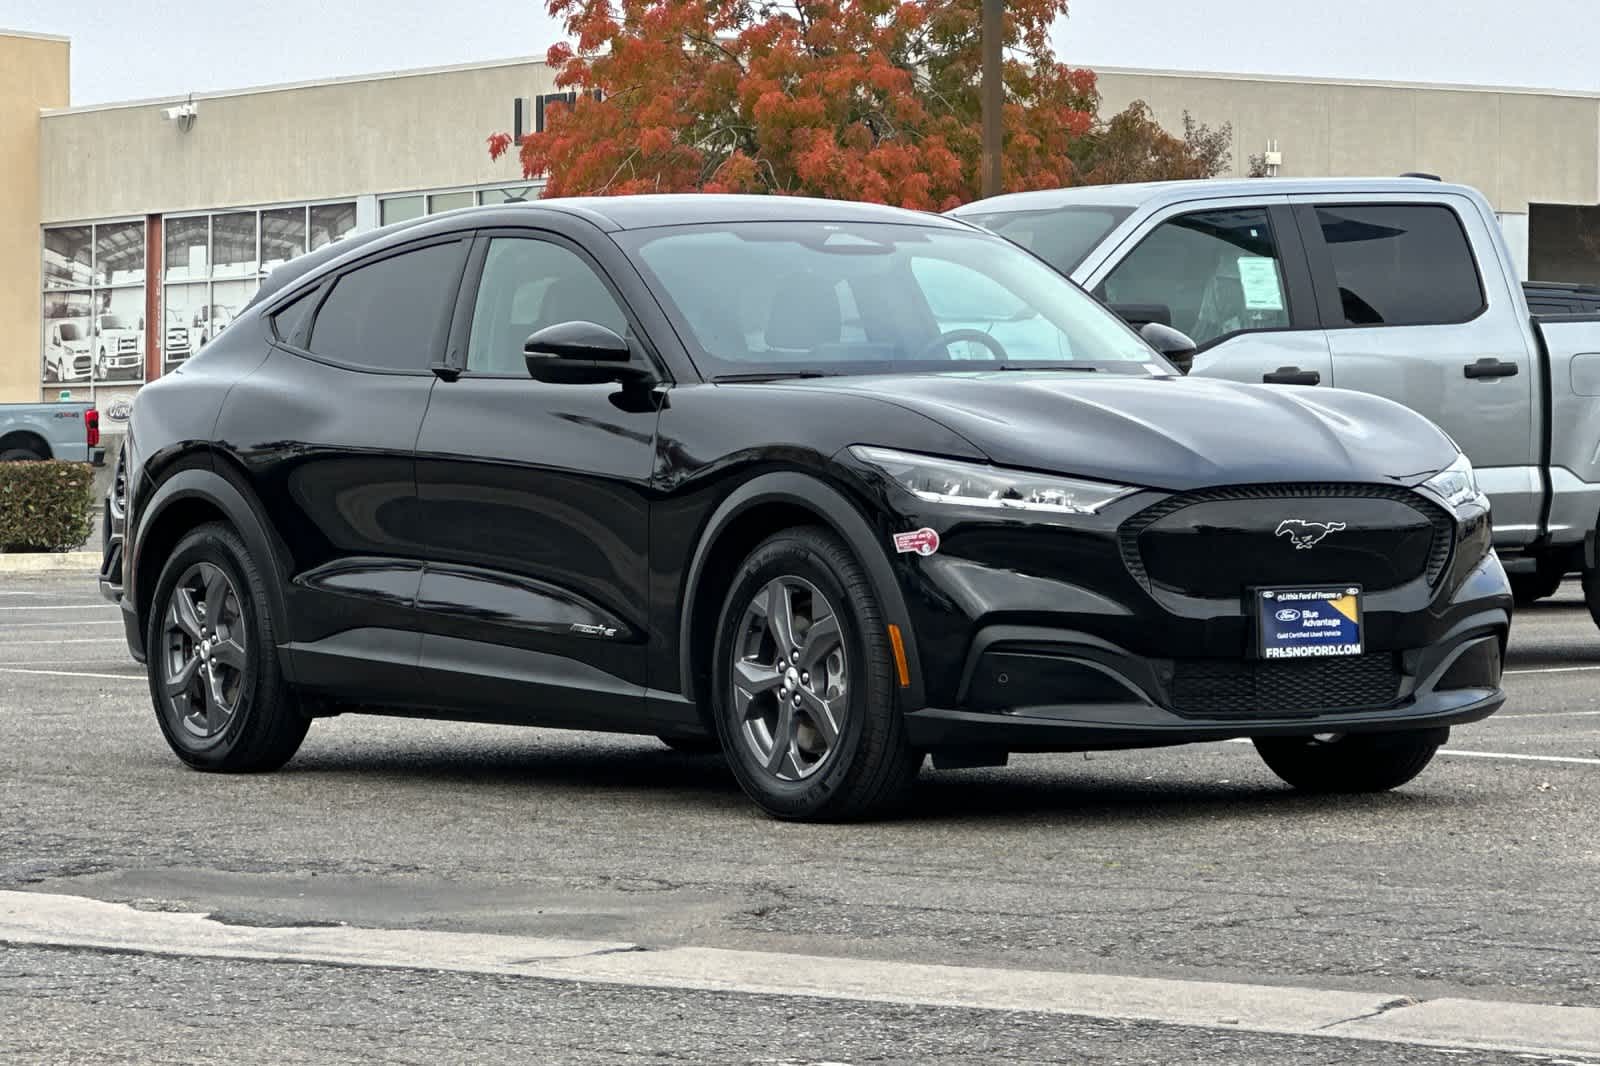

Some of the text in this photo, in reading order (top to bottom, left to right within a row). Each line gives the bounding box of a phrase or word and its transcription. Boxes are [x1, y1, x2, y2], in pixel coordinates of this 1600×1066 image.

[1299, 592, 1311, 600] Ford
[1302, 610, 1319, 618] Blue
[1303, 618, 1341, 627] Advantage
[1265, 645, 1361, 658] FRESNOFORD.COM
